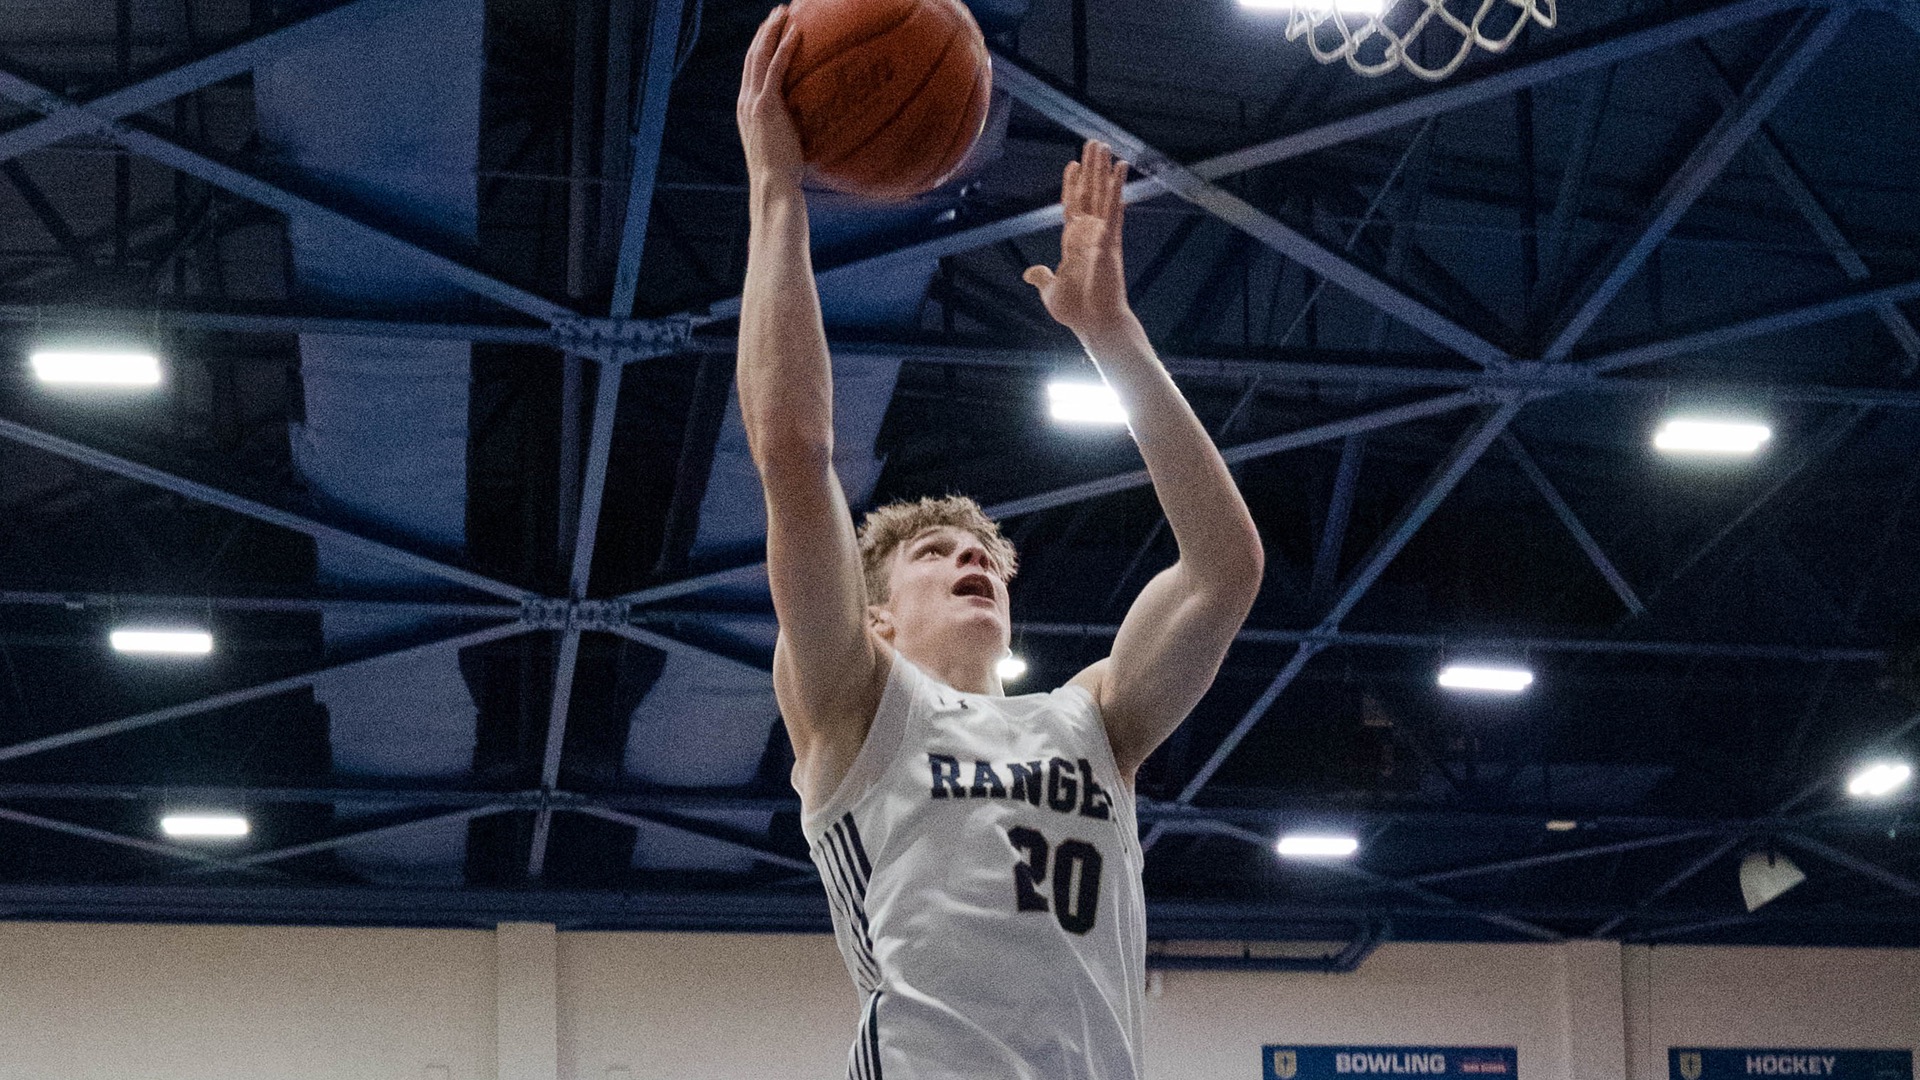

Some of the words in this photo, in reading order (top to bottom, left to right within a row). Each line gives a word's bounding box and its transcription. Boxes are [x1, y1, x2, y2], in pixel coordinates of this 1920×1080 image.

[1008, 825, 1103, 935] 20
[1336, 1052, 1446, 1074] BOWLING
[1746, 1054, 1836, 1076] HOCKEY
